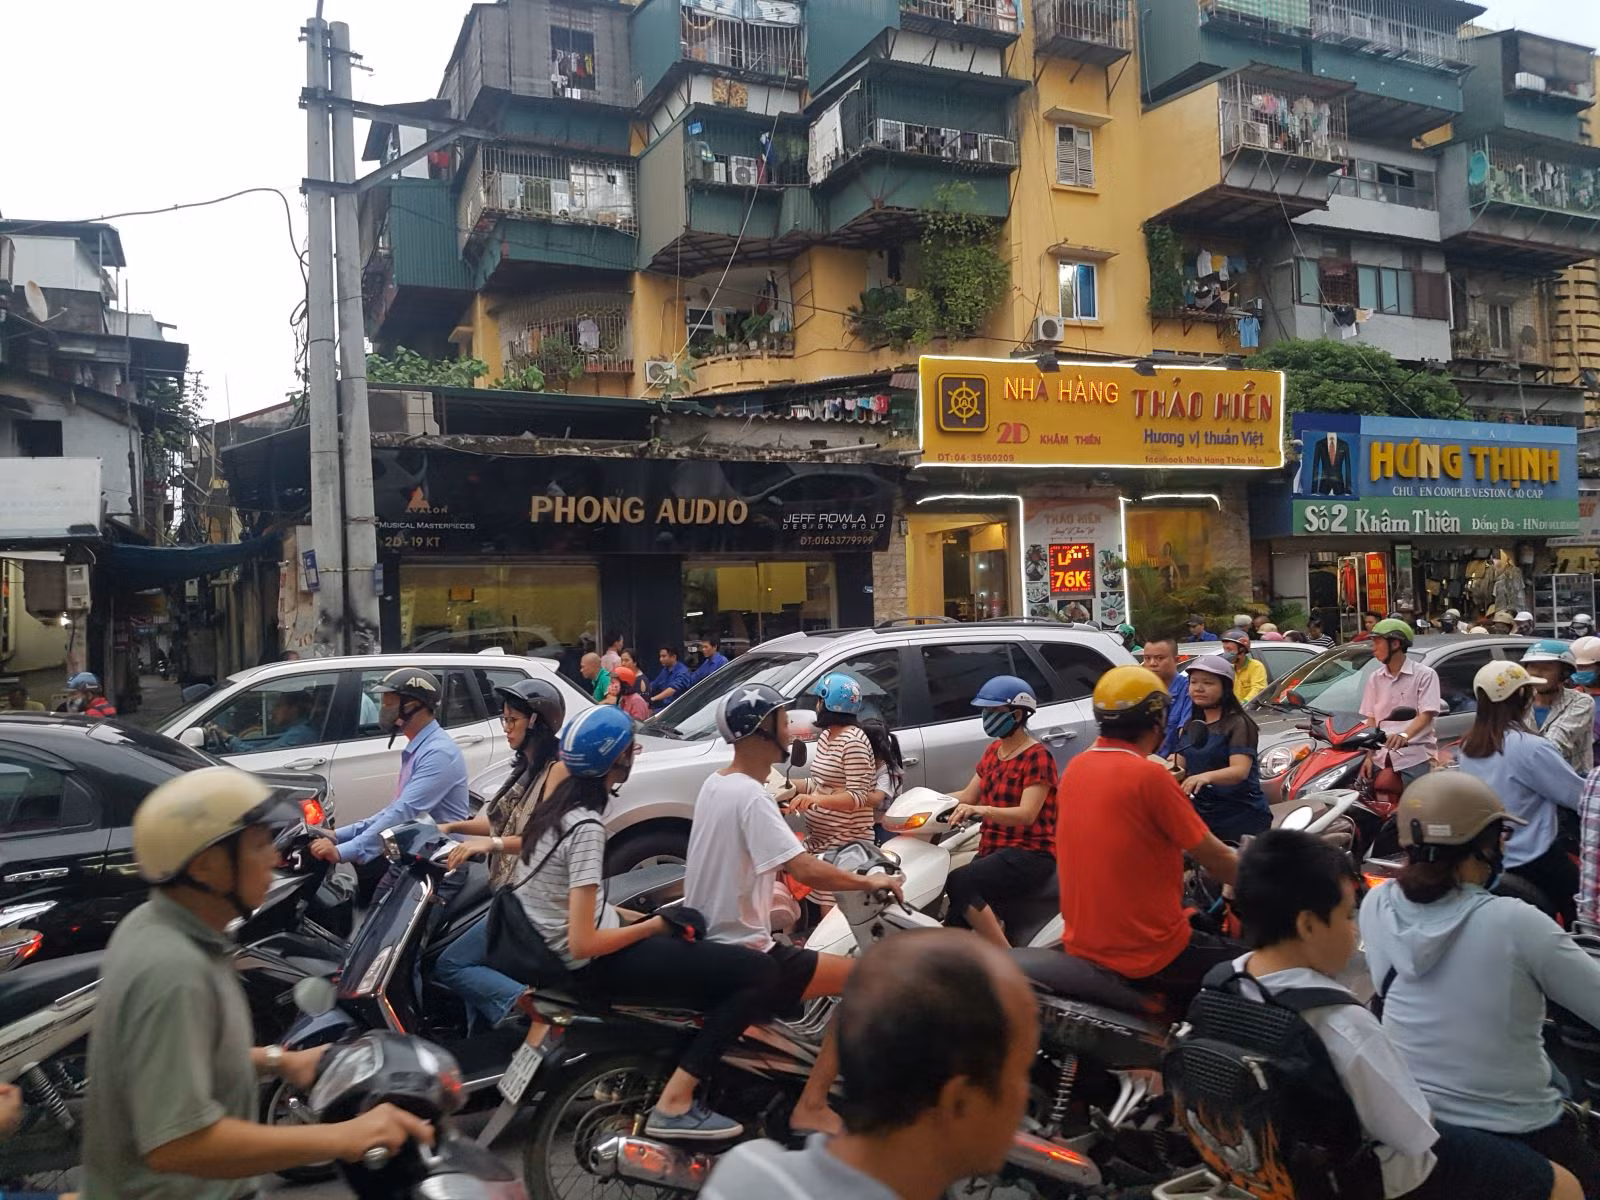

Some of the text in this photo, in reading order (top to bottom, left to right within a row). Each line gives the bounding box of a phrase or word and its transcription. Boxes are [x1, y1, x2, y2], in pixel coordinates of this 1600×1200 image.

[1004, 372, 1119, 404] NHÀ HÀNG
[1132, 377, 1204, 420] THẢO
[997, 422, 1030, 444] 2D
[1241, 431, 1264, 449] Việt
[1469, 445, 1560, 489] THỊNH
[1433, 487, 1471, 498] COMPLE
[1472, 488, 1506, 498] VESTON
[530, 495, 748, 525] PHONG AUDIO
[783, 513, 816, 523] JEFF
[1355, 508, 1410, 533] Khâm
[1412, 509, 1461, 533] Thiên
[1501, 518, 1515, 530] Đa
[426, 537, 441, 547] KT
[1054, 571, 1087, 588] 76K
